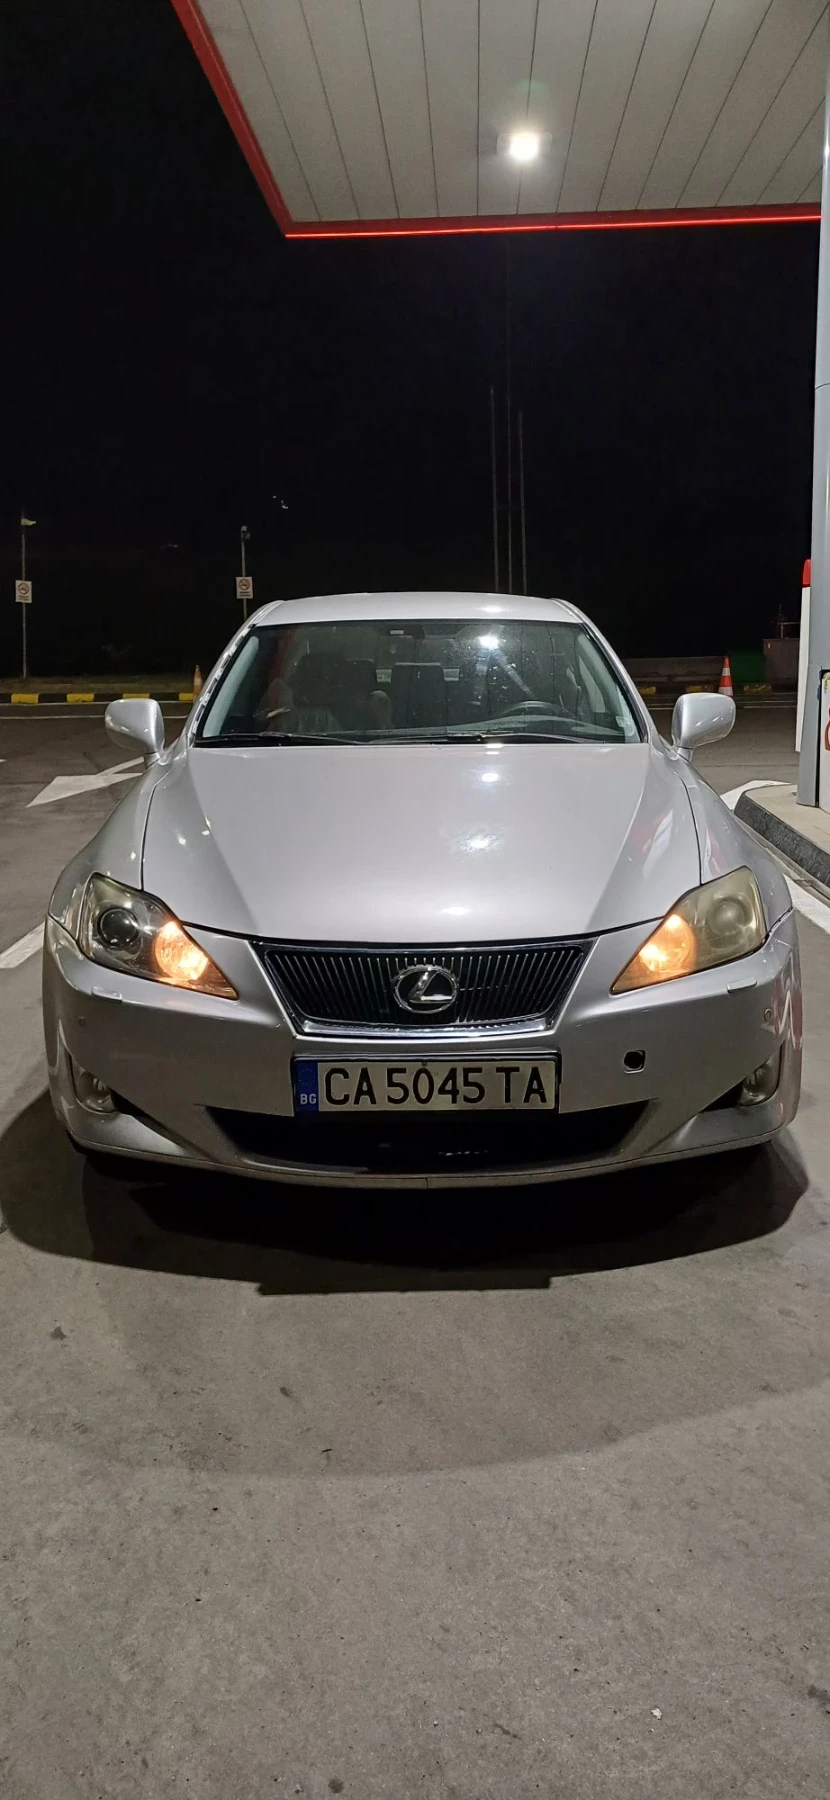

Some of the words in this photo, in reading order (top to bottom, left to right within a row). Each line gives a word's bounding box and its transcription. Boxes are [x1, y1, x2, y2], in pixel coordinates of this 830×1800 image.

[325, 1067, 377, 1105] CA
[387, 1067, 486, 1104] 5045
[496, 1066, 547, 1104] TA
[300, 1093, 317, 1105] BG
